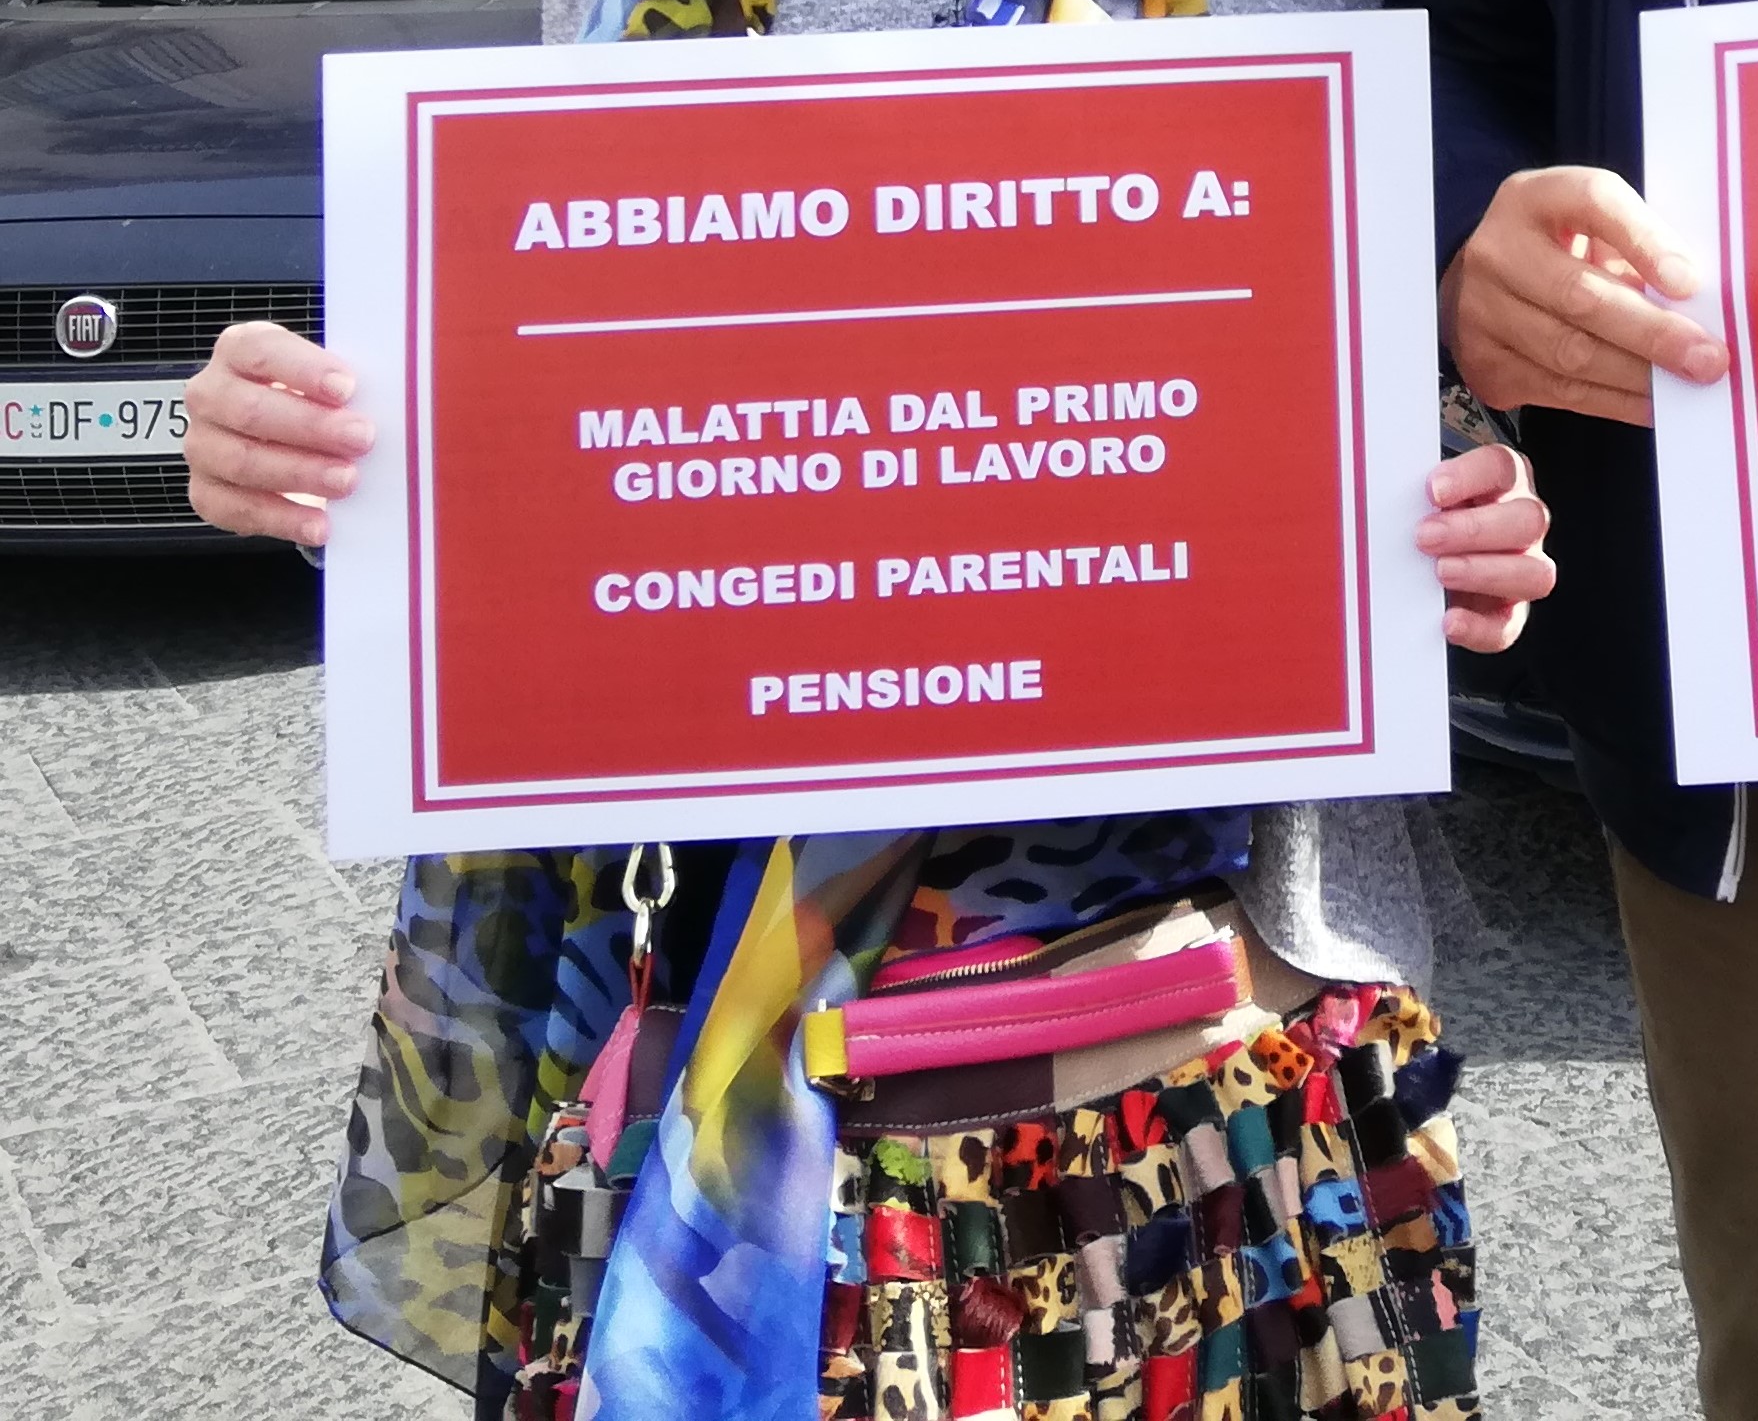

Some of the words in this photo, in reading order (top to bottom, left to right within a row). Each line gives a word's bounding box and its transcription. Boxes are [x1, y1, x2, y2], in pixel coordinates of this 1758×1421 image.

[514, 188, 850, 251] ABBIAMO
[875, 173, 1160, 234] DIRITTO
[1182, 170, 1250, 219] A:
[68, 315, 102, 342] FIAT
[579, 397, 871, 449] MALATTIA
[890, 390, 998, 433] DAL
[1017, 378, 1198, 426] PRIMO
[614, 452, 842, 502] GIORNO
[862, 447, 918, 489] DI
[940, 434, 1166, 484] LAVORO
[594, 561, 855, 613] CONGEDI
[877, 541, 1188, 597] PARENTALI
[750, 660, 1043, 715] PENSIONE
